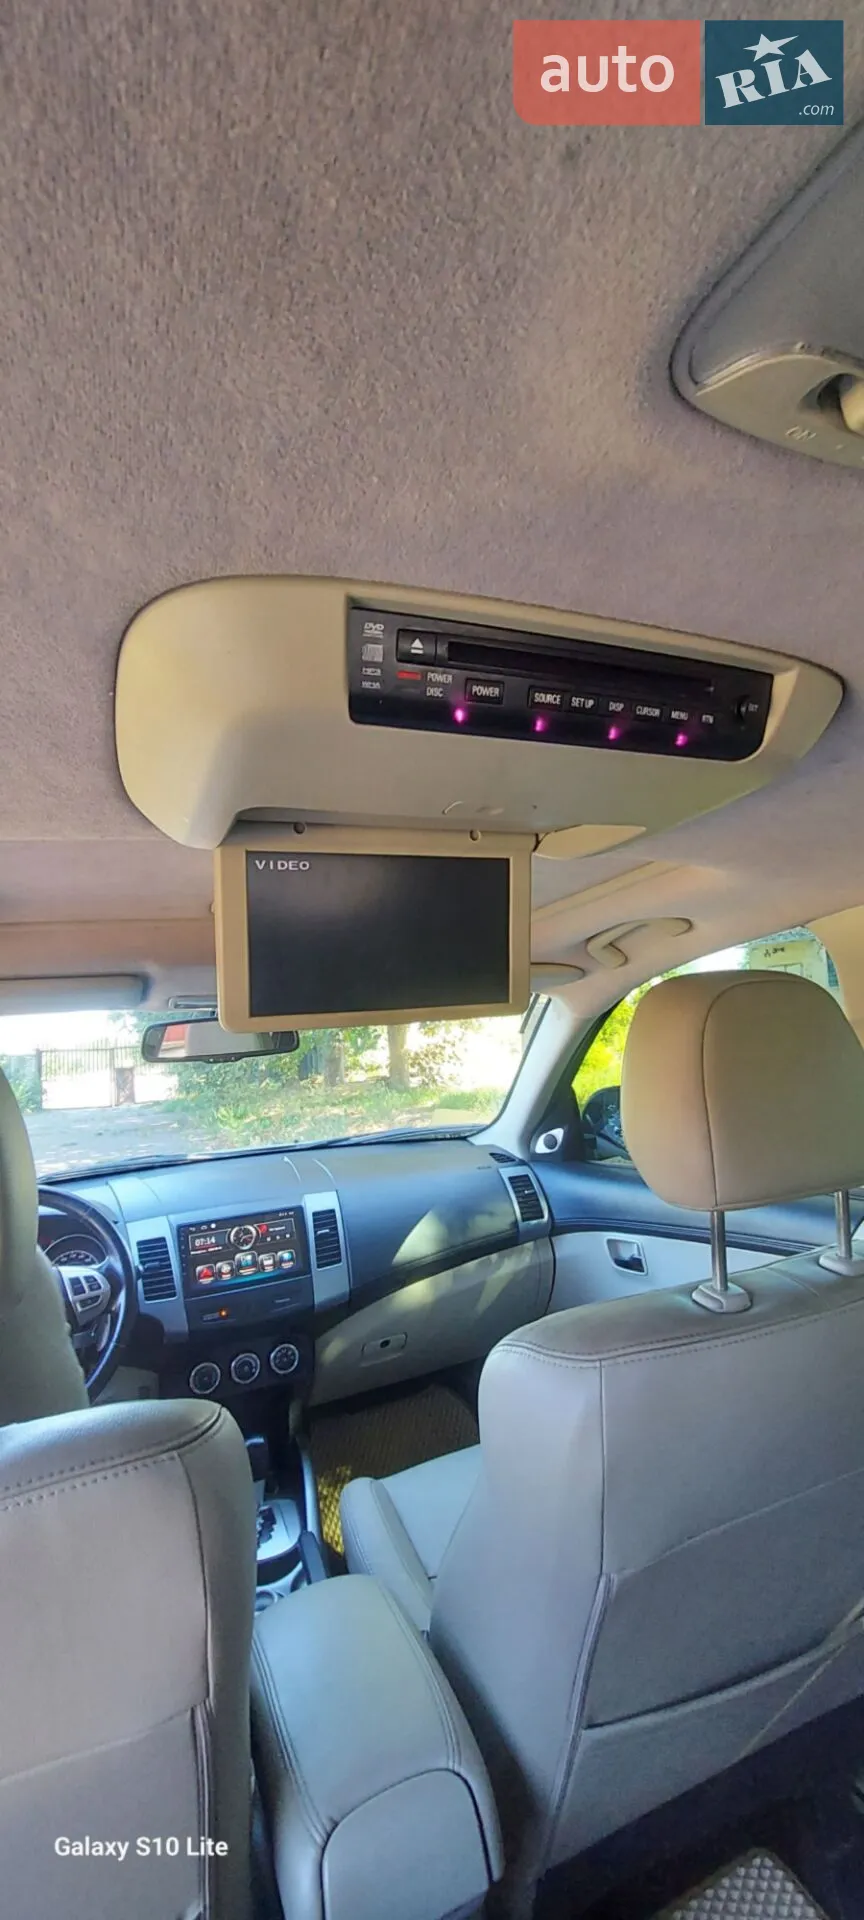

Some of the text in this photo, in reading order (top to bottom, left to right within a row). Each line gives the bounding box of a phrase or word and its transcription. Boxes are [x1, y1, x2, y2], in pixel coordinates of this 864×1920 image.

[427, 672, 453, 684] POWER
[426, 687, 444, 698] DISC
[471, 685, 500, 698] POWER
[534, 692, 562, 706] SOURCE
[608, 701, 625, 713] DISP
[635, 705, 661, 718] CURSOR
[671, 711, 688, 722] MENU
[255, 860, 310, 870] VIDEO
